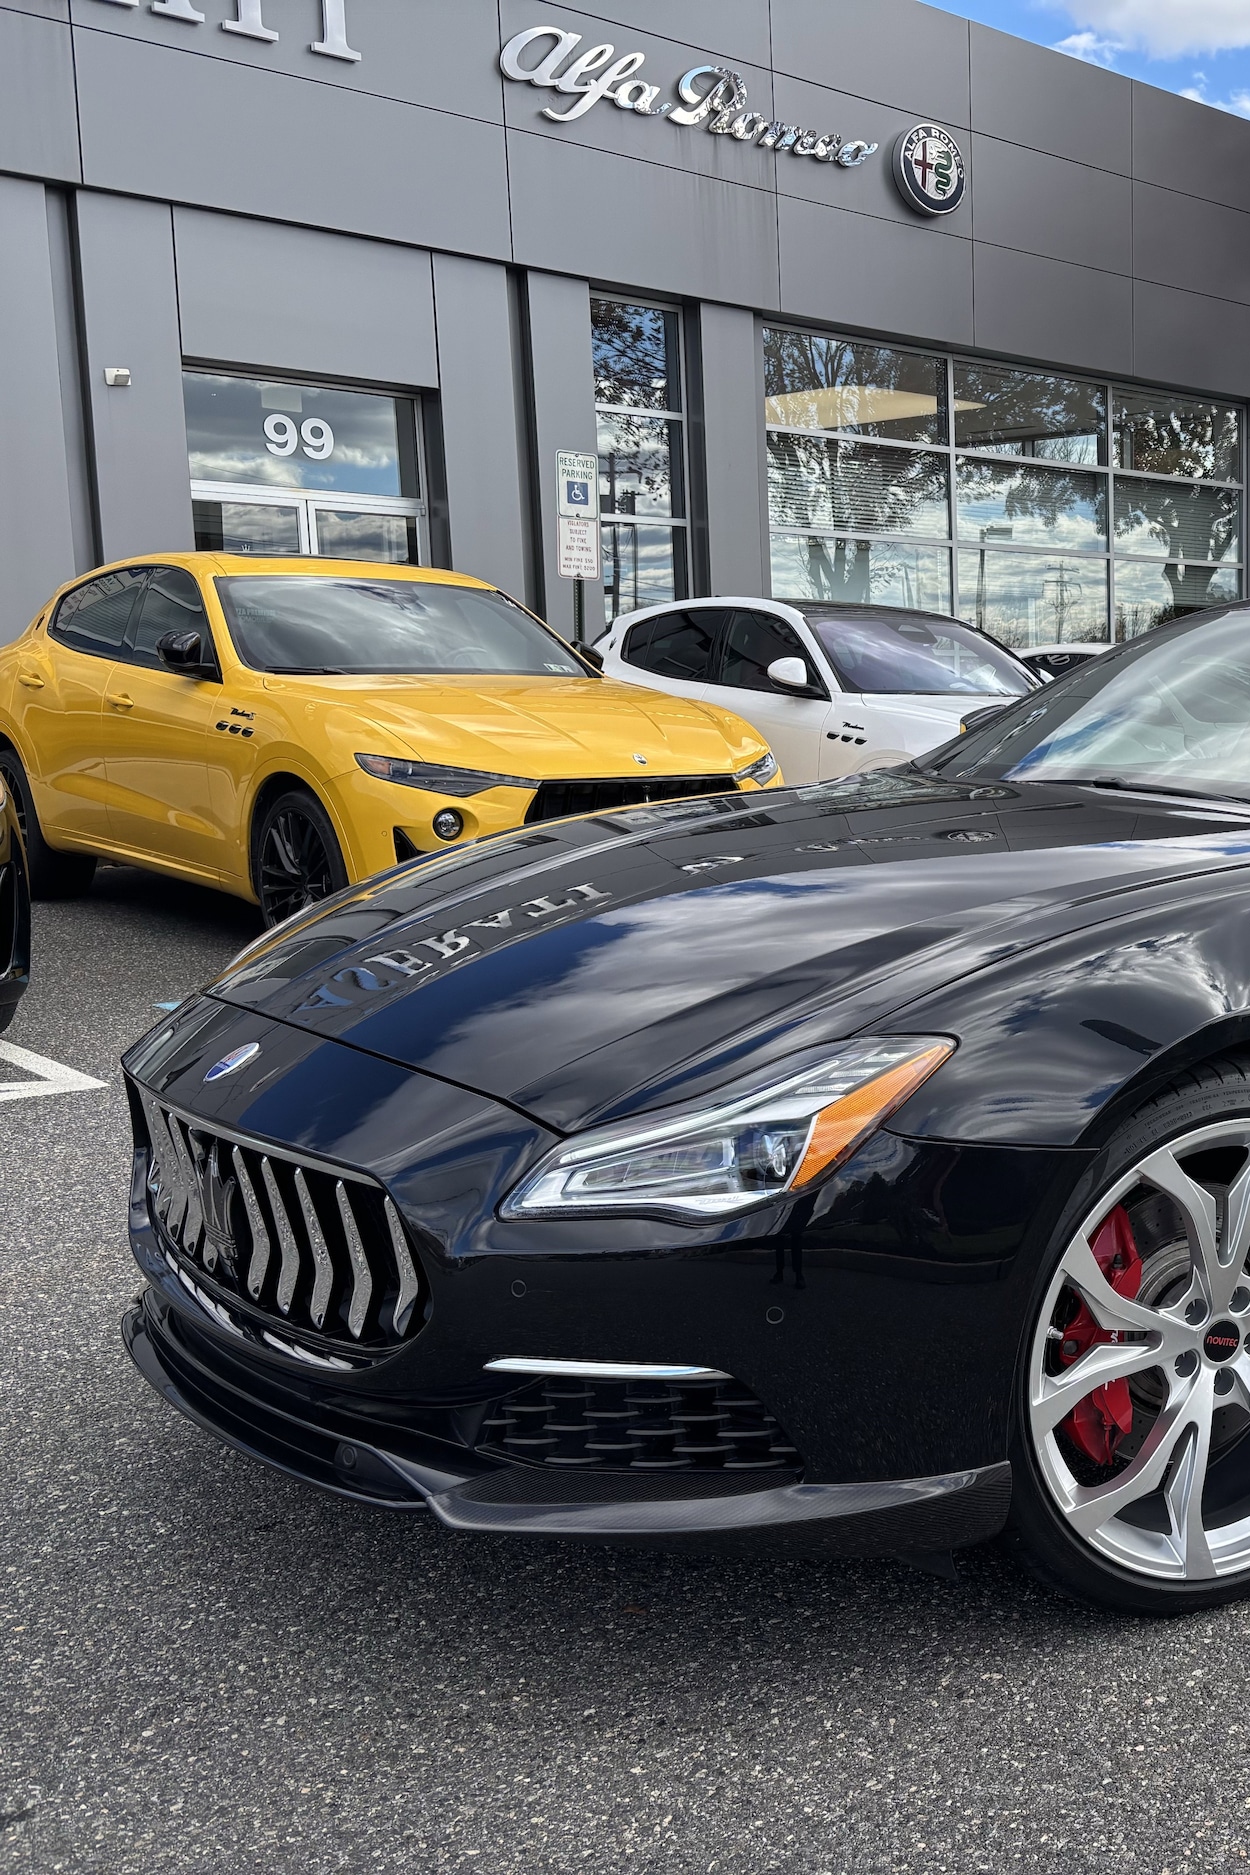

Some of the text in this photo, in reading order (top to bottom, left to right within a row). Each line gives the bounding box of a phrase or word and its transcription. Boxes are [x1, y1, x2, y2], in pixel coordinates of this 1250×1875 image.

[499, 25, 879, 168] Alfa Romeo
[904, 128, 964, 179] ALFA ROMEO
[263, 413, 335, 460] 99
[559, 456, 595, 470] RESERVED
[561, 468, 593, 480] PARKING
[567, 520, 590, 528] VIOLATORS
[569, 528, 587, 536] SUBJECT
